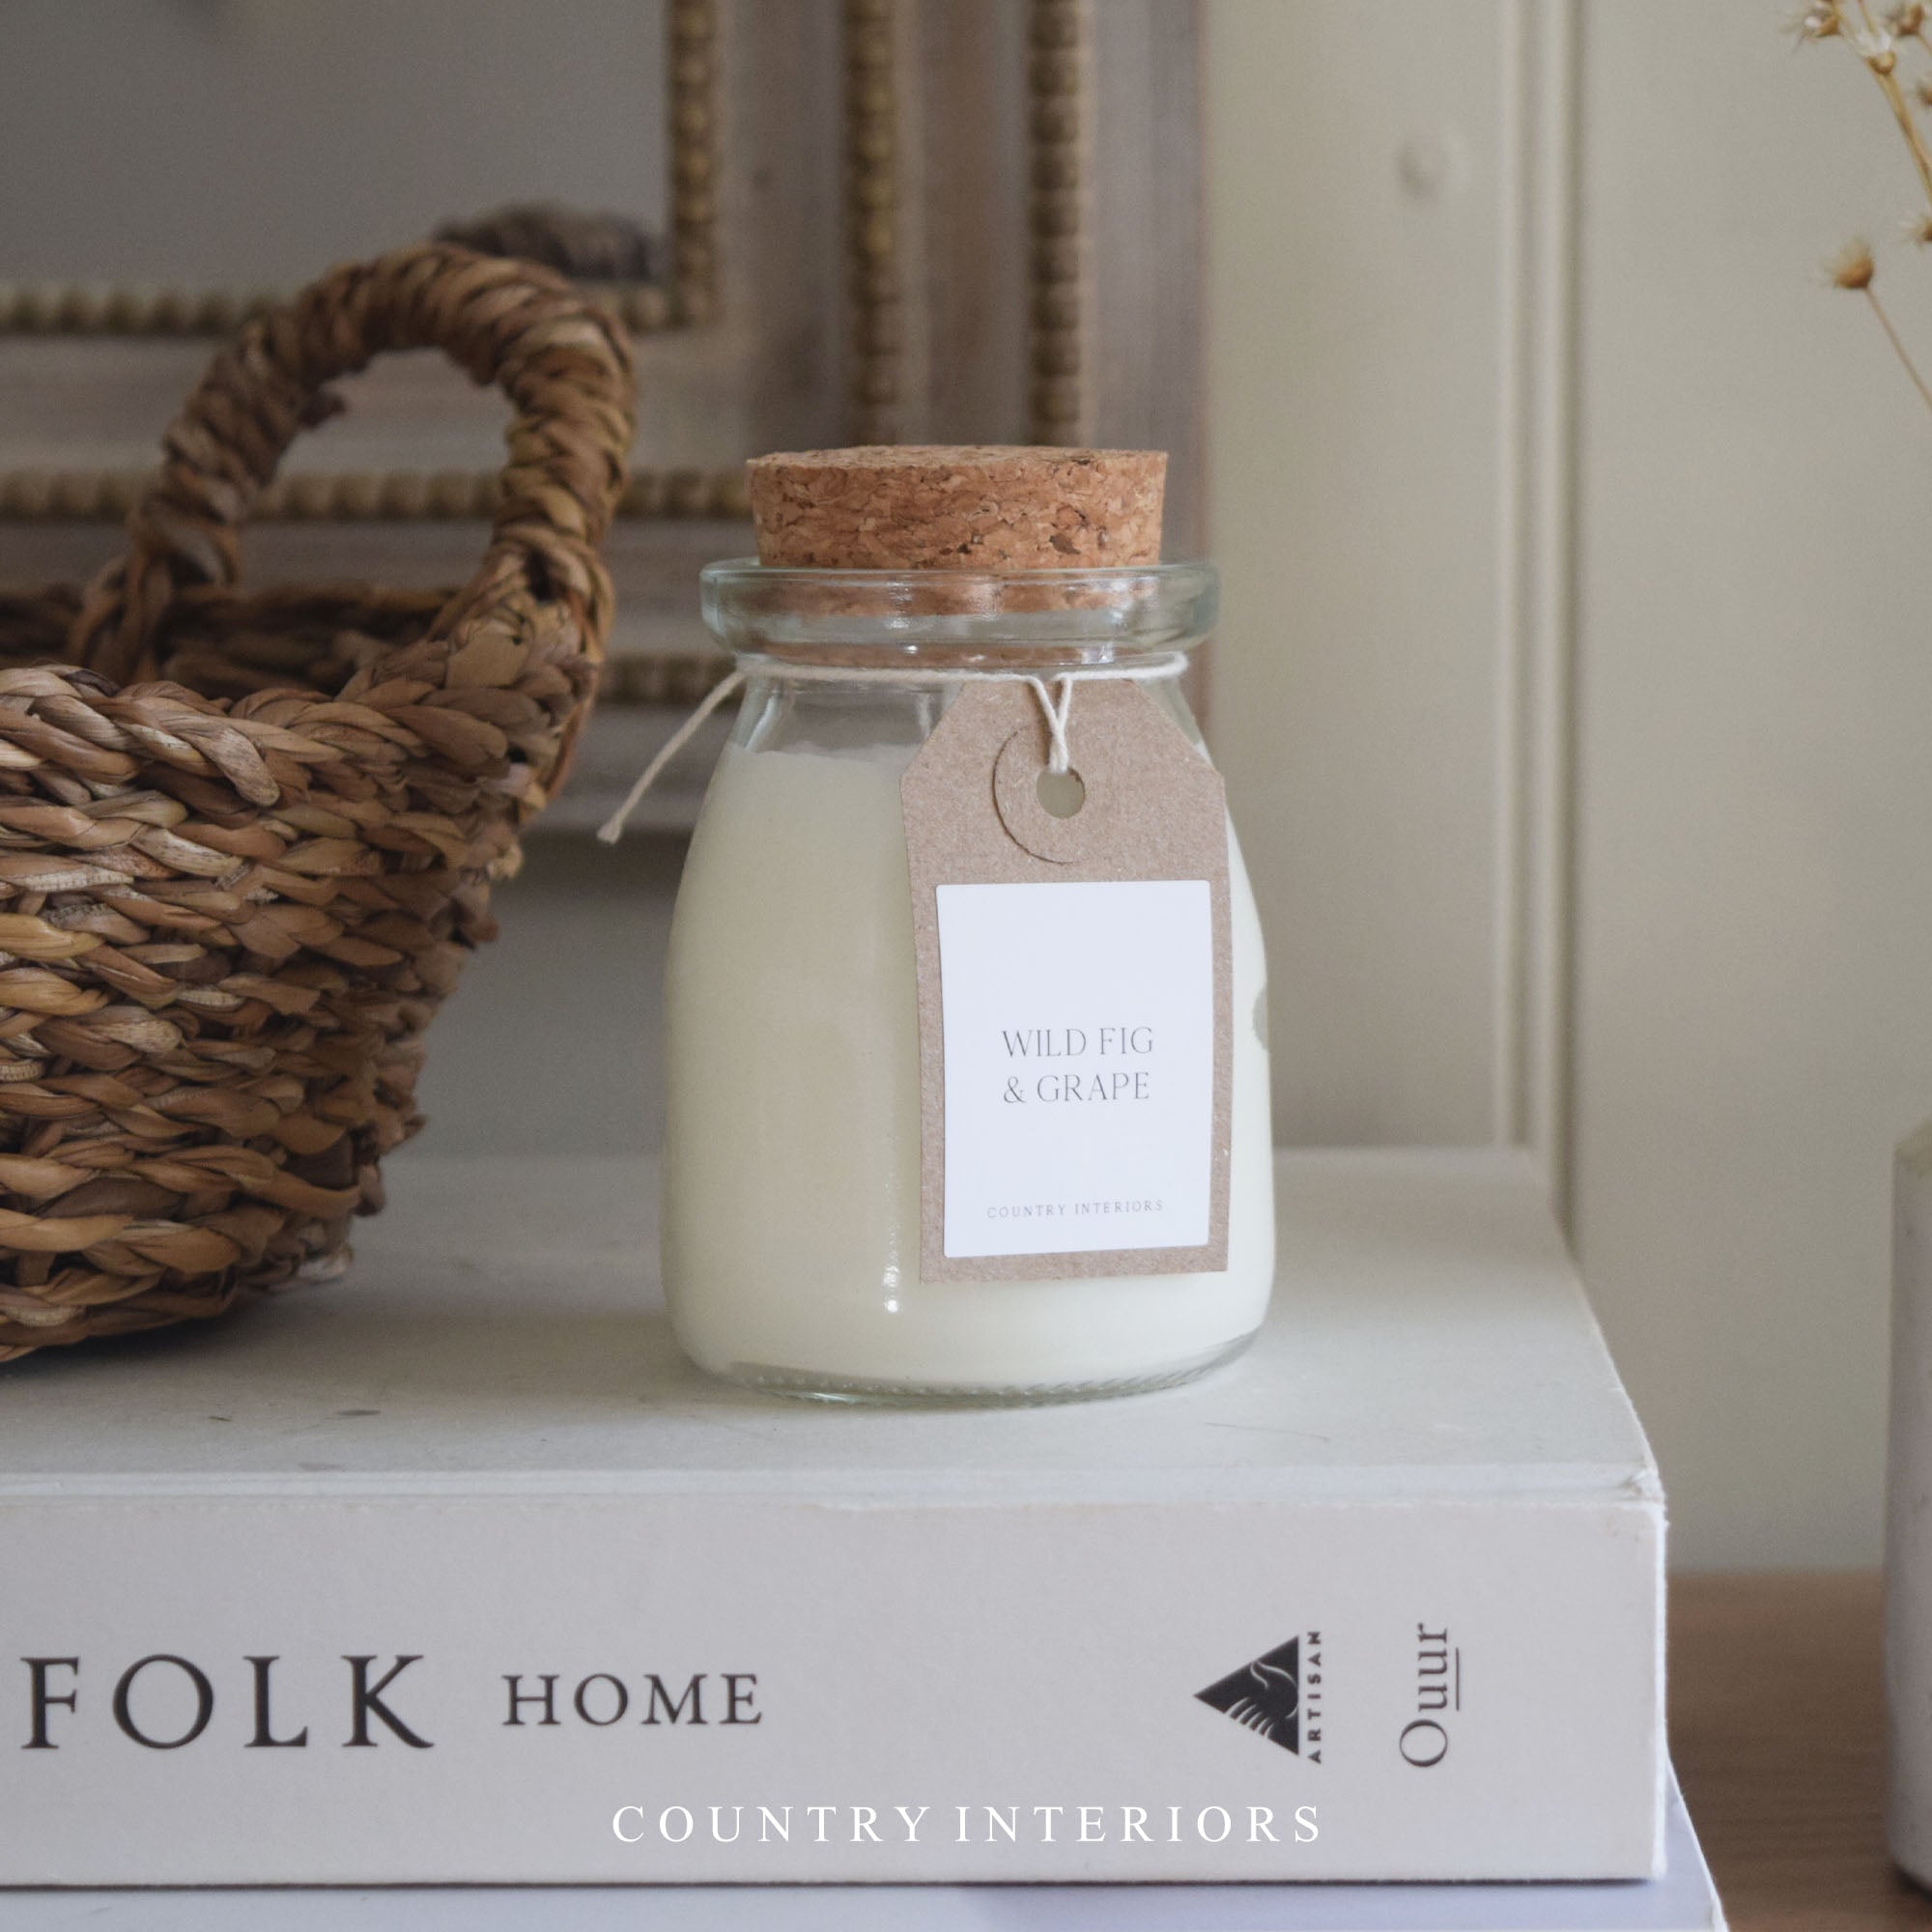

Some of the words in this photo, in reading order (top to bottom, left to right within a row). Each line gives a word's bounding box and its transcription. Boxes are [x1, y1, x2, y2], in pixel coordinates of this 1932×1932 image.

[1001, 1028, 1088, 1059] WILD
[1098, 1026, 1154, 1056] FIG
[1002, 1075, 1027, 1104] &
[1036, 1071, 1151, 1103] GRAPE
[986, 1203, 1066, 1219] COUNTRY
[1074, 1199, 1164, 1214] INTERIORS
[19, 1653, 436, 1750] FOLK
[500, 1672, 763, 1727] HOME
[1306, 1631, 1322, 1765] ARTISAN
[1399, 1622, 1448, 1769] Ouur
